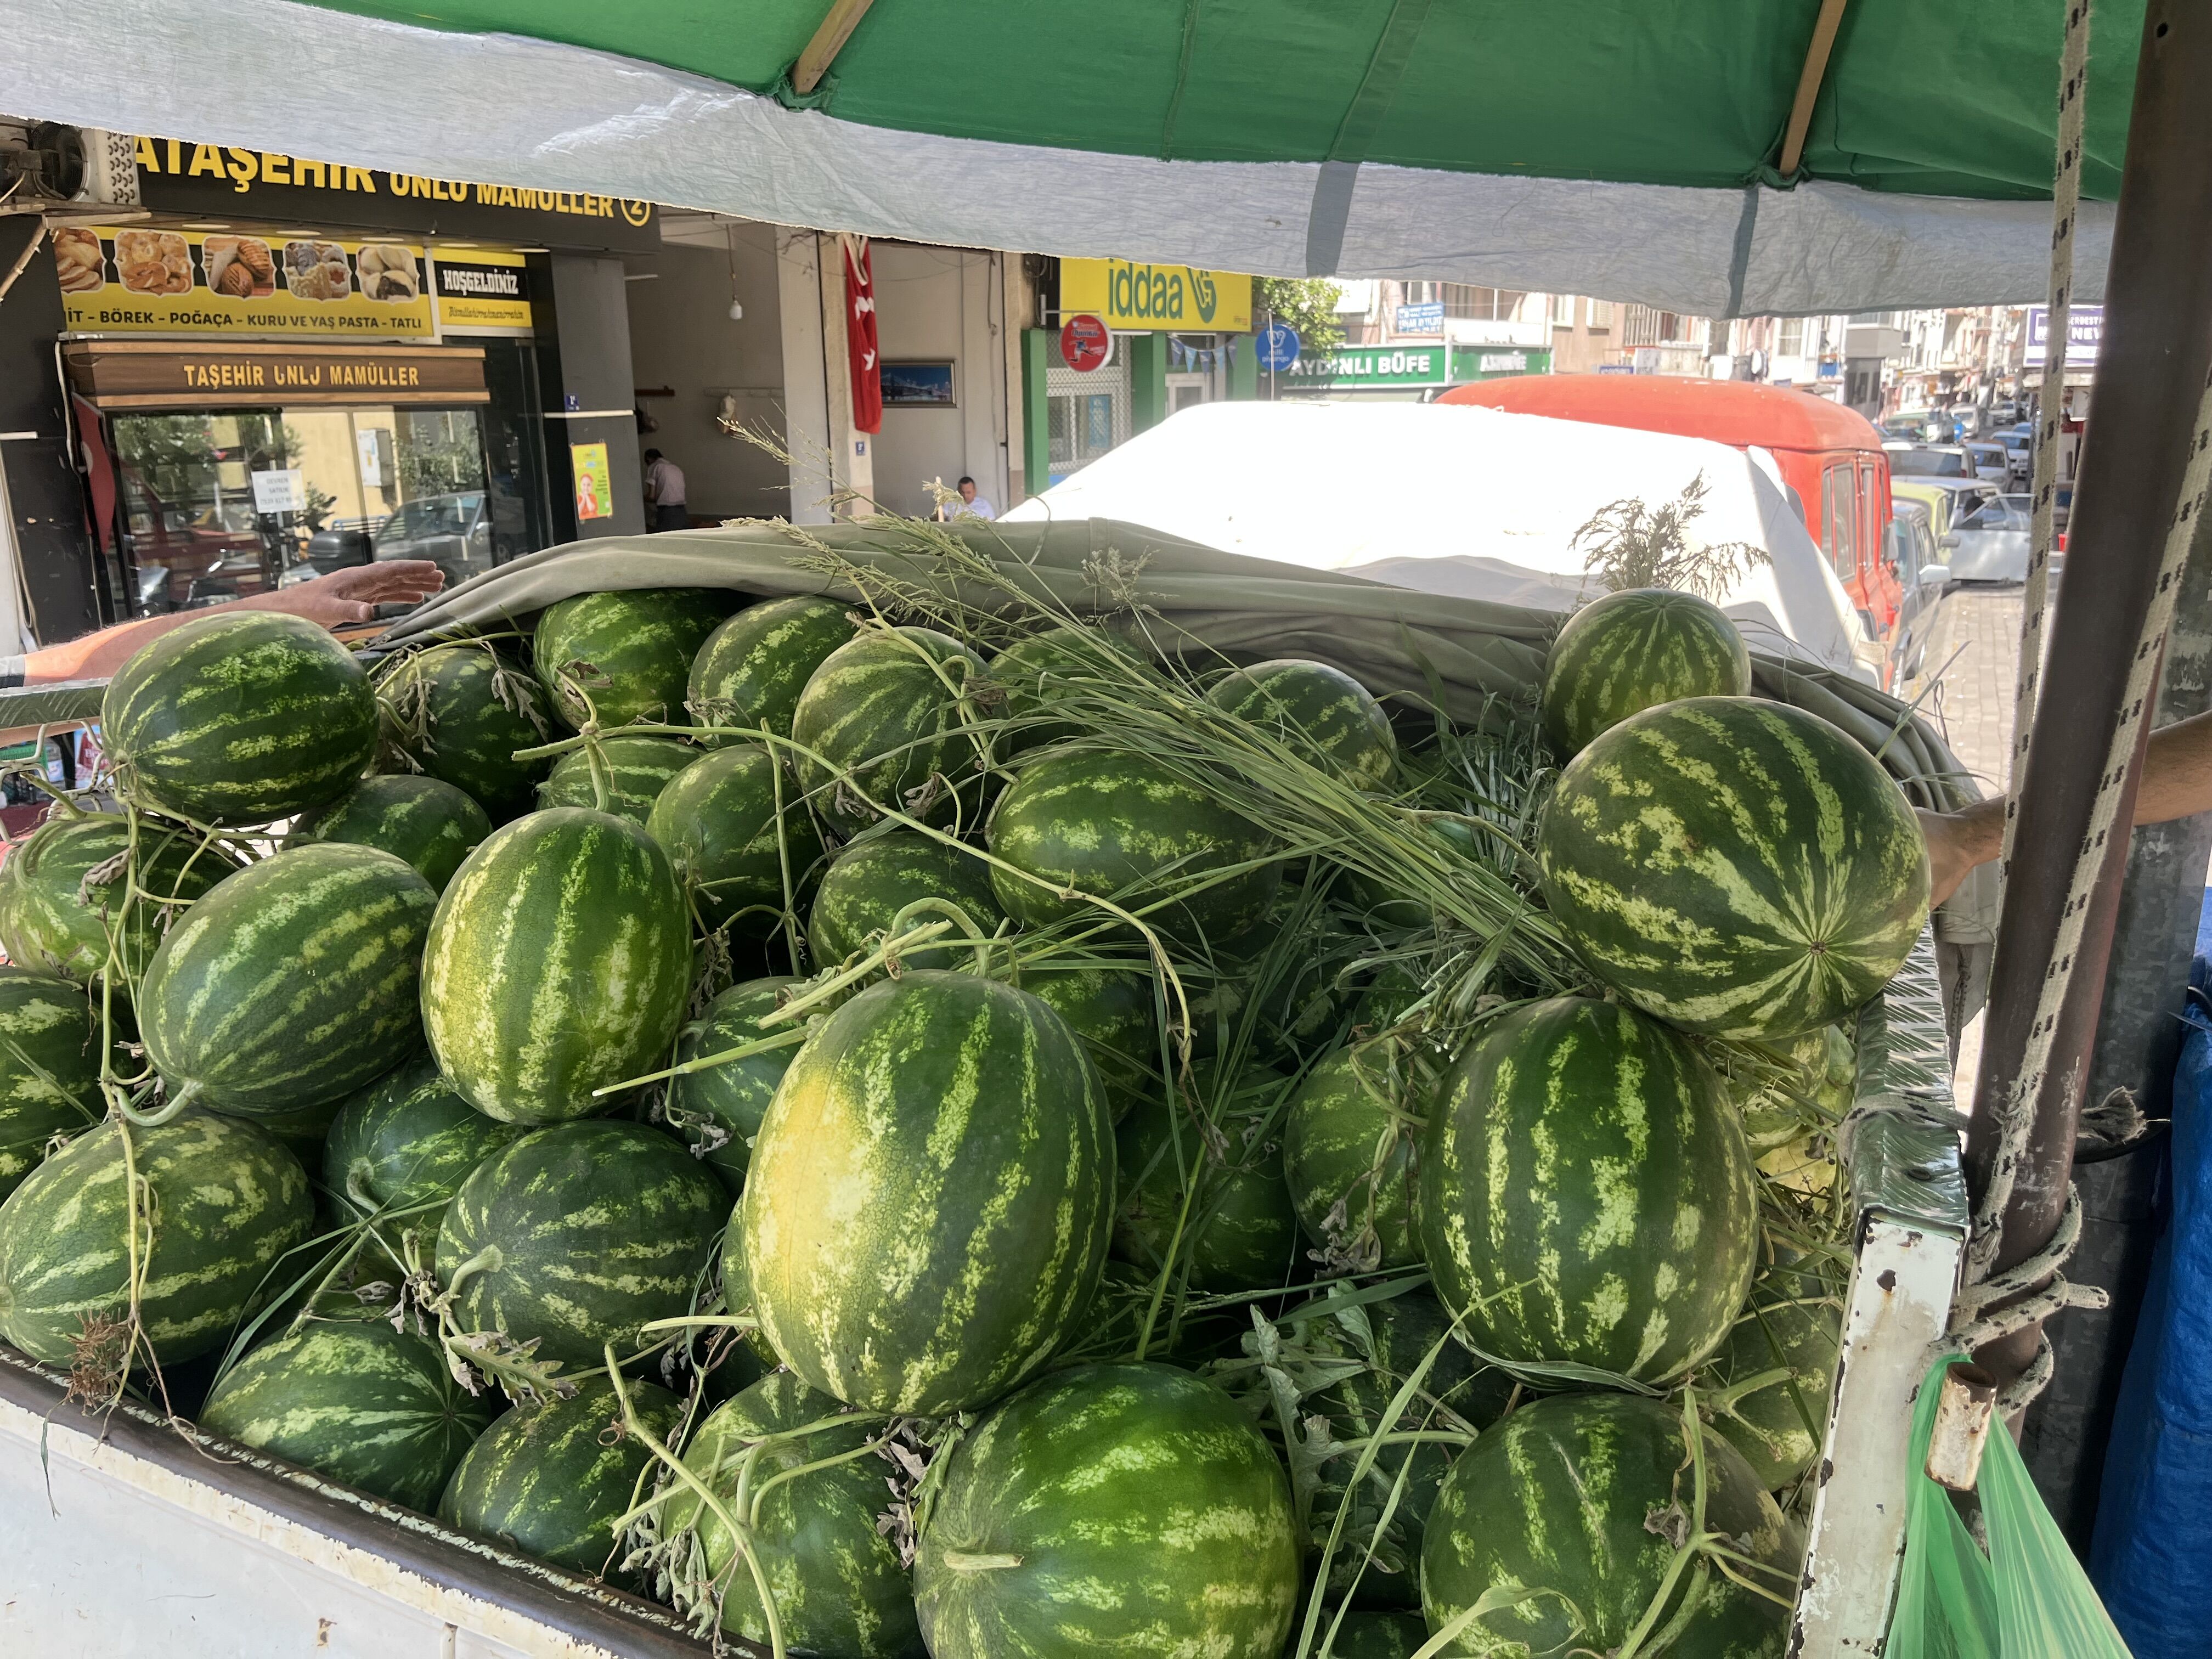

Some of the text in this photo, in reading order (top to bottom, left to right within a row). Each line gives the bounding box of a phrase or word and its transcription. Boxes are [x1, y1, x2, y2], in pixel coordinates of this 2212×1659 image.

[442, 268, 519, 296] HOŞGELDİNİZ
[1108, 258, 1183, 319] iddaa
[64, 307, 83, 323] İT
[99, 308, 154, 324] BÖREK
[170, 310, 233, 328] POĞAÇA
[247, 314, 287, 326] KURU
[289, 315, 307, 327] VE
[308, 316, 335, 330] YAŞ
[338, 317, 379, 328] PASTA
[390, 318, 422, 329] TATLI
[183, 360, 264, 390] TAŞEHİR
[329, 362, 419, 386] MAMÜLLER
[1378, 351, 1430, 374] BÜFE
